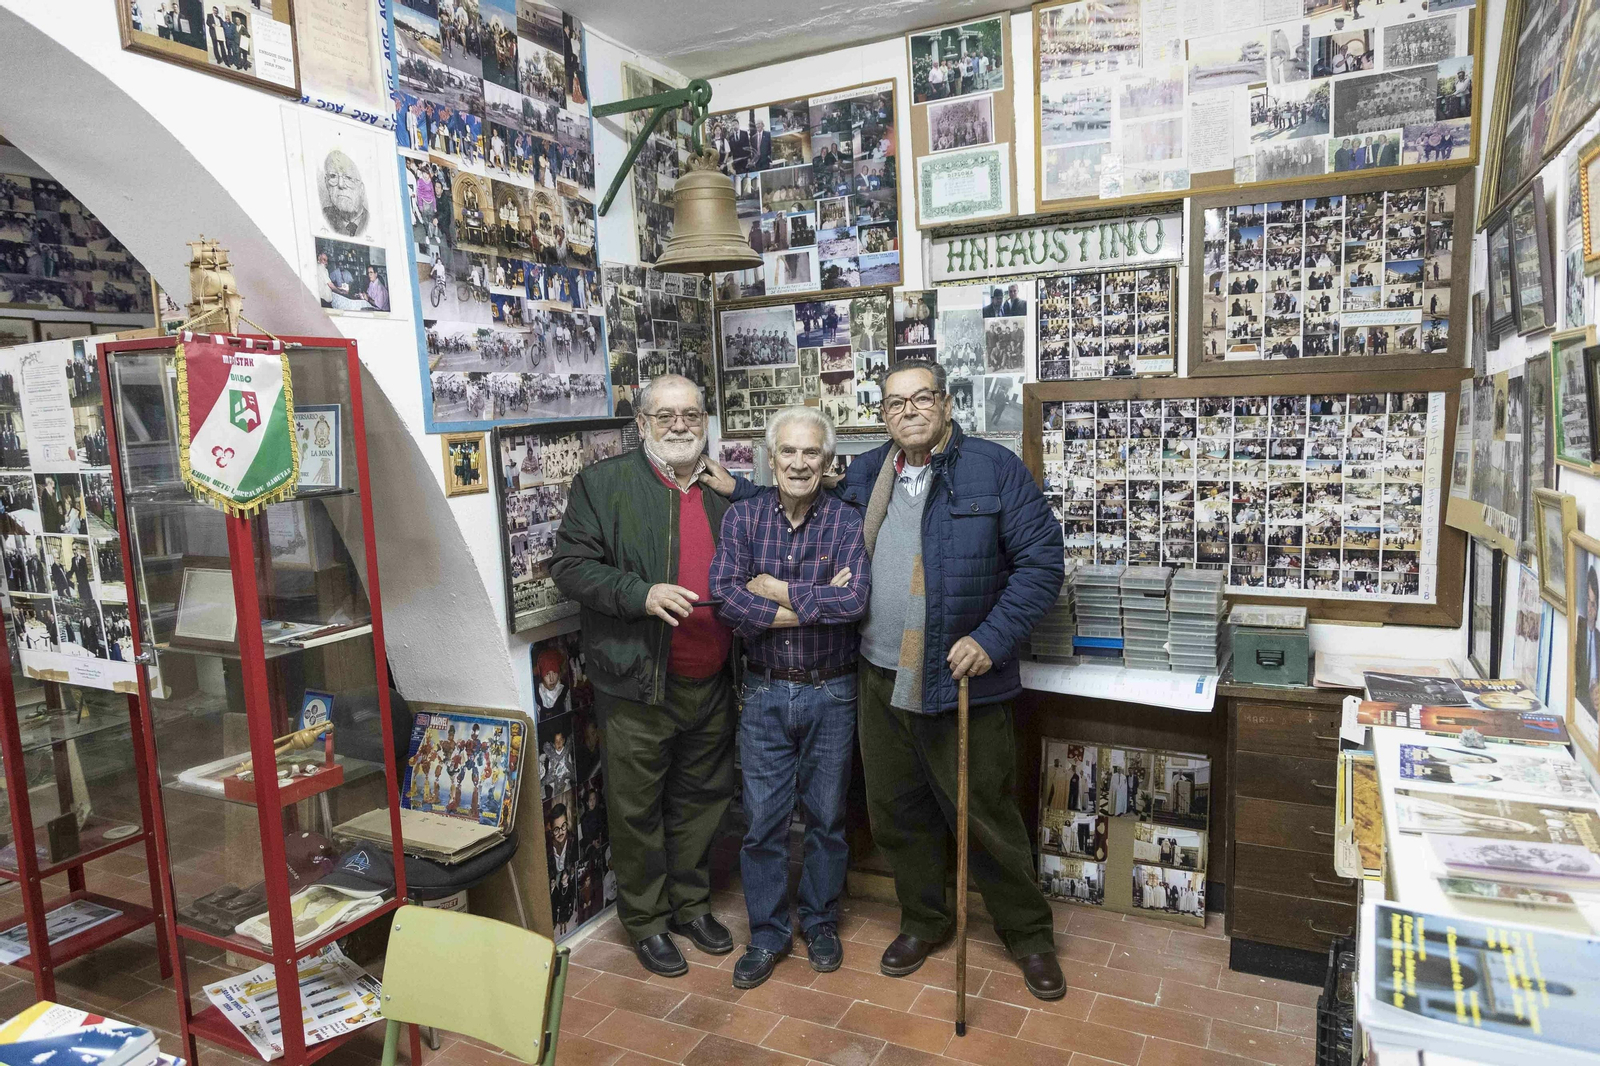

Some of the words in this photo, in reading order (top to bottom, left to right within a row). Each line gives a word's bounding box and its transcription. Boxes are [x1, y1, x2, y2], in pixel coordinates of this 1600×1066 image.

[378, 0, 387, 20] AG
[381, 27, 392, 61] AGC
[316, 99, 344, 114] AGC
[350, 109, 379, 125] AGC
[947, 170, 974, 179] DIPLOMA
[230, 373, 252, 383] BILBO
[1428, 393, 1442, 456] FIESTA
[429, 715, 447, 726] MARVEL
